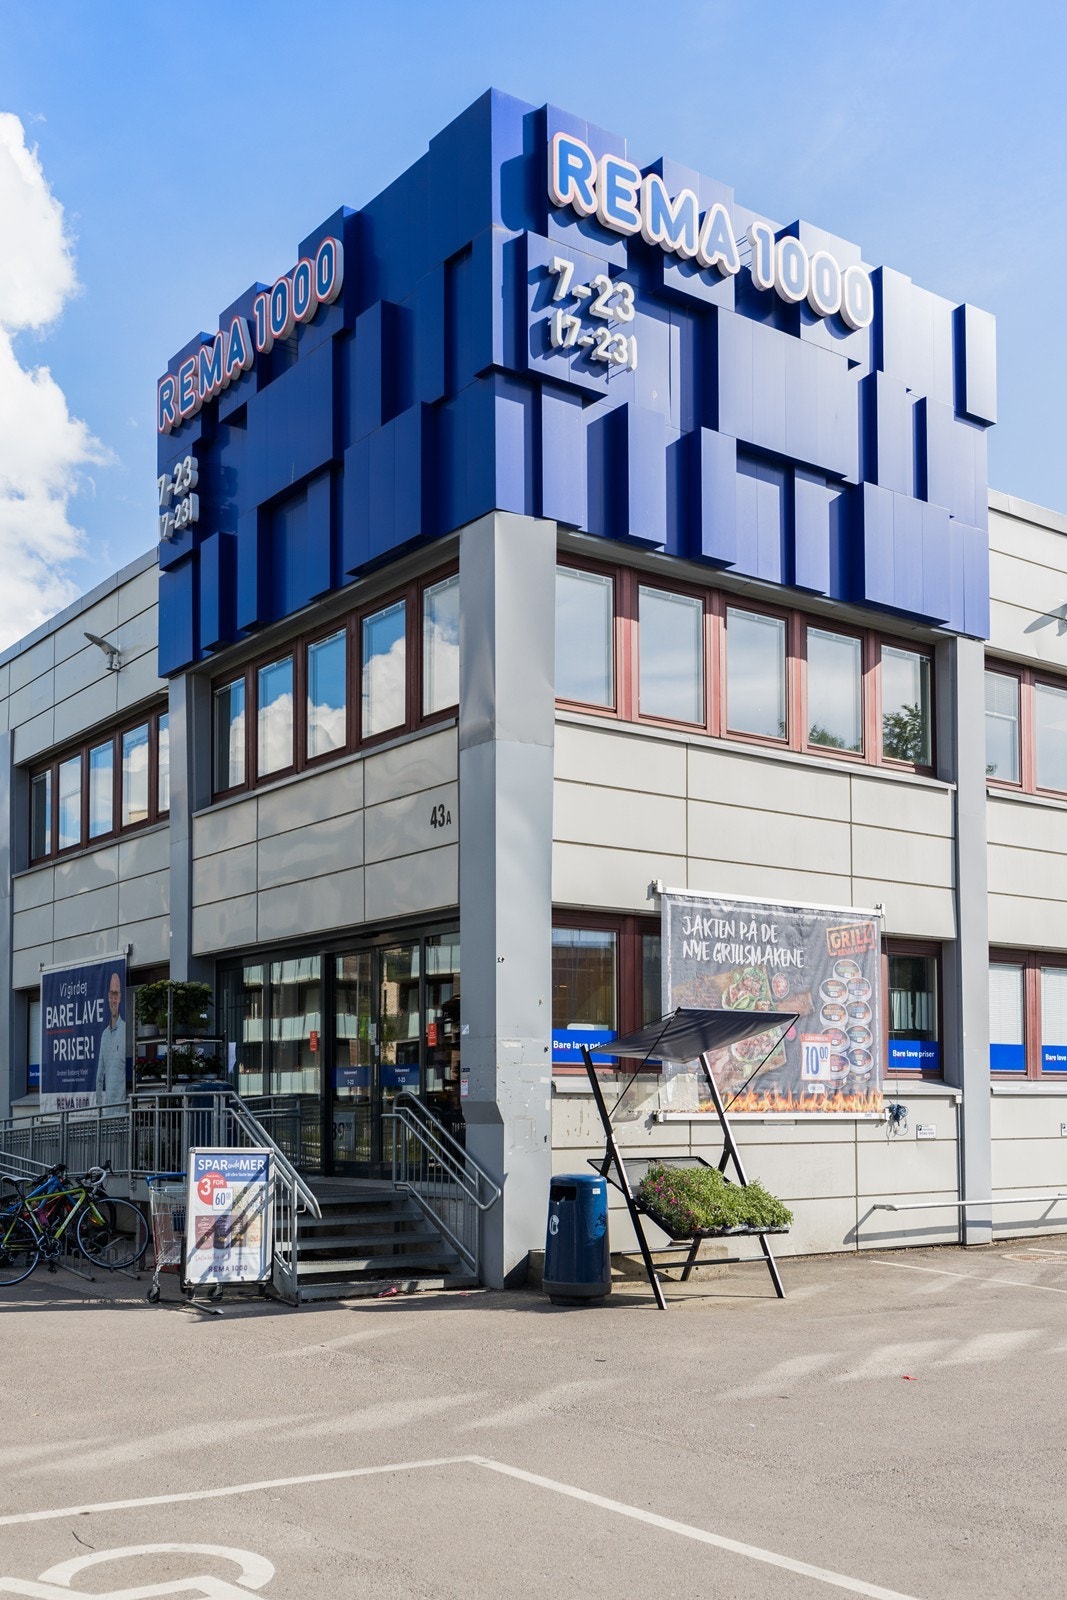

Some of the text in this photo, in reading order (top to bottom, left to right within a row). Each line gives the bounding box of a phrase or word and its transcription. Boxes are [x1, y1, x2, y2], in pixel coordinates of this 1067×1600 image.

[548, 132, 874, 331] REMA 1000
[548, 256, 635, 324] 7-23
[157, 236, 344, 435] REMA 1000
[550, 308, 637, 372] (7-23)
[157, 455, 199, 505] 7-23
[430, 803, 452, 829] 43A
[682, 914, 778, 943] JAKTEN PÅ DE
[830, 927, 872, 950] GRILL
[683, 940, 805, 968] NYE GRILLSMAKENE
[46, 998, 104, 1029] BARE LAVE
[53, 1035, 95, 1062] PRISER!
[553, 1040, 571, 1050] Bare
[892, 1049, 935, 1058] Bare lave priser
[1045, 1053, 1056, 1061] Bare
[805, 1046, 829, 1075] 10 00
[198, 1159, 229, 1171] SPAR
[239, 1159, 265, 1170] MER
[200, 1177, 211, 1196] 3
[215, 1192, 226, 1206] 60
[208, 1264, 248, 1273] REMA 1000
